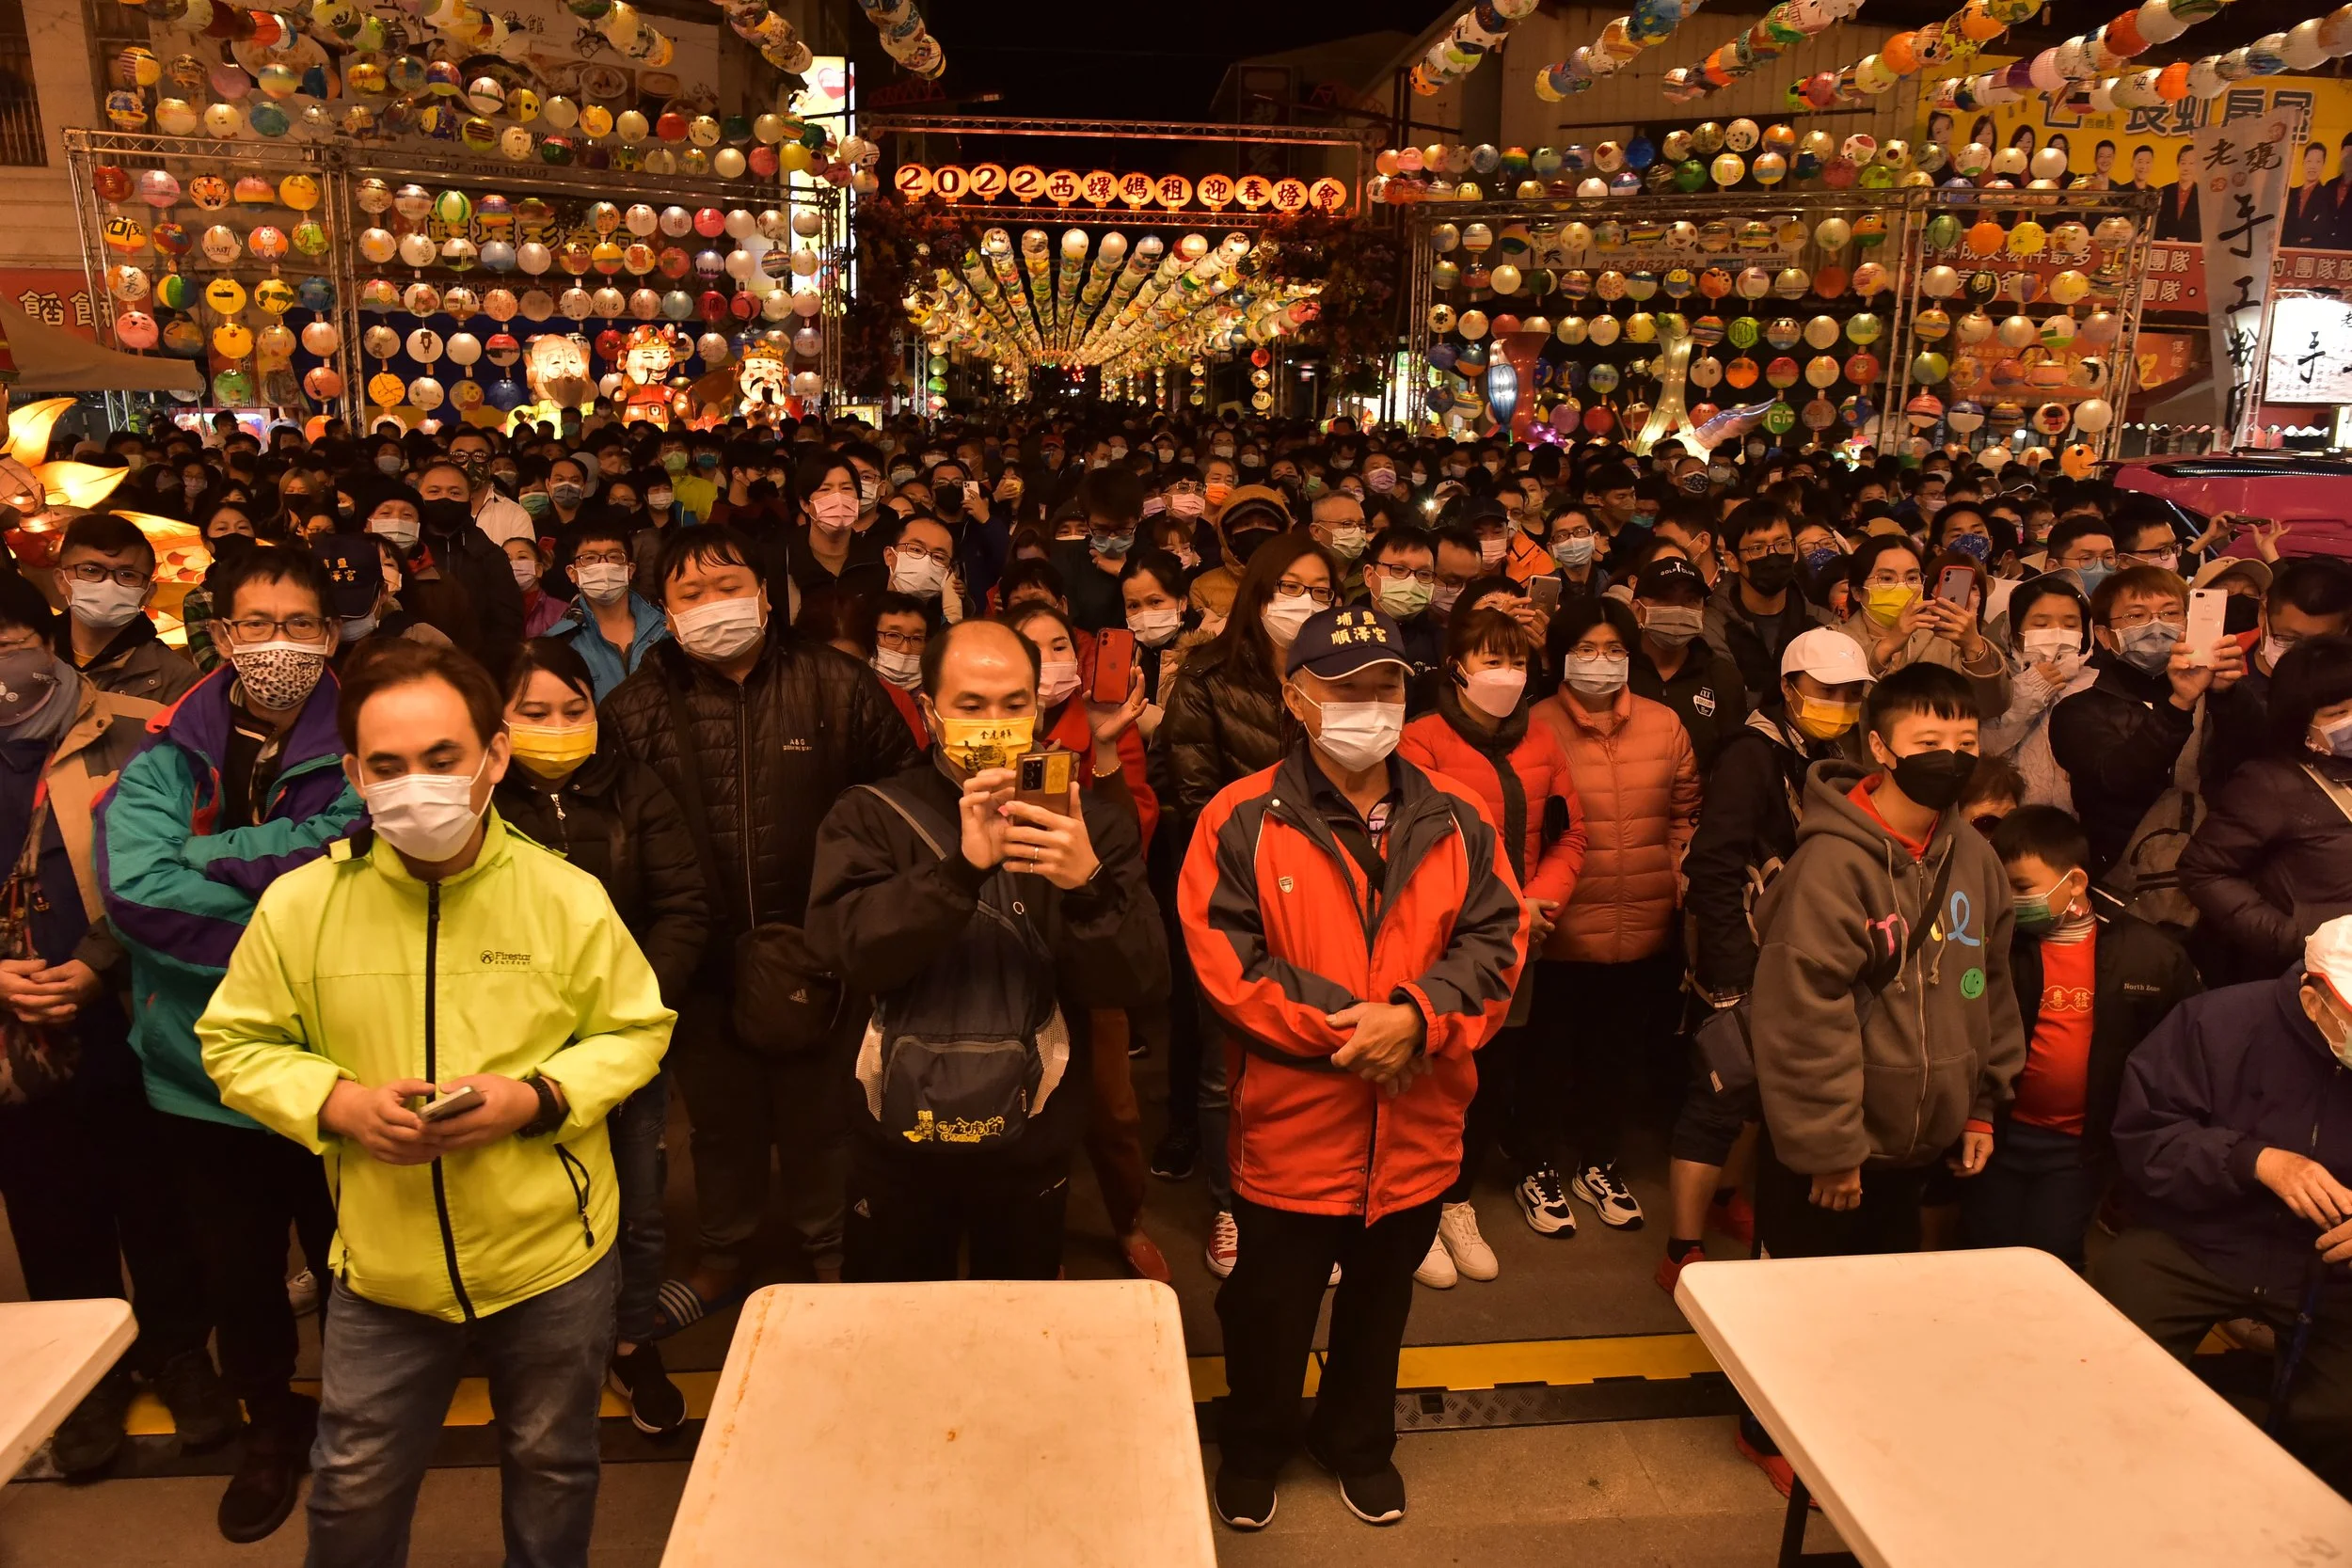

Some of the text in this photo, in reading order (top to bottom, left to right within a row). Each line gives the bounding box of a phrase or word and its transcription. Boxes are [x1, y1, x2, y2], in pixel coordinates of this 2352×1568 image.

[1330, 626, 1388, 645] 順澤宮
[495, 951, 532, 961] Firestar
[2123, 982, 2145, 991] North
[2040, 990, 2090, 1008] 喜發
